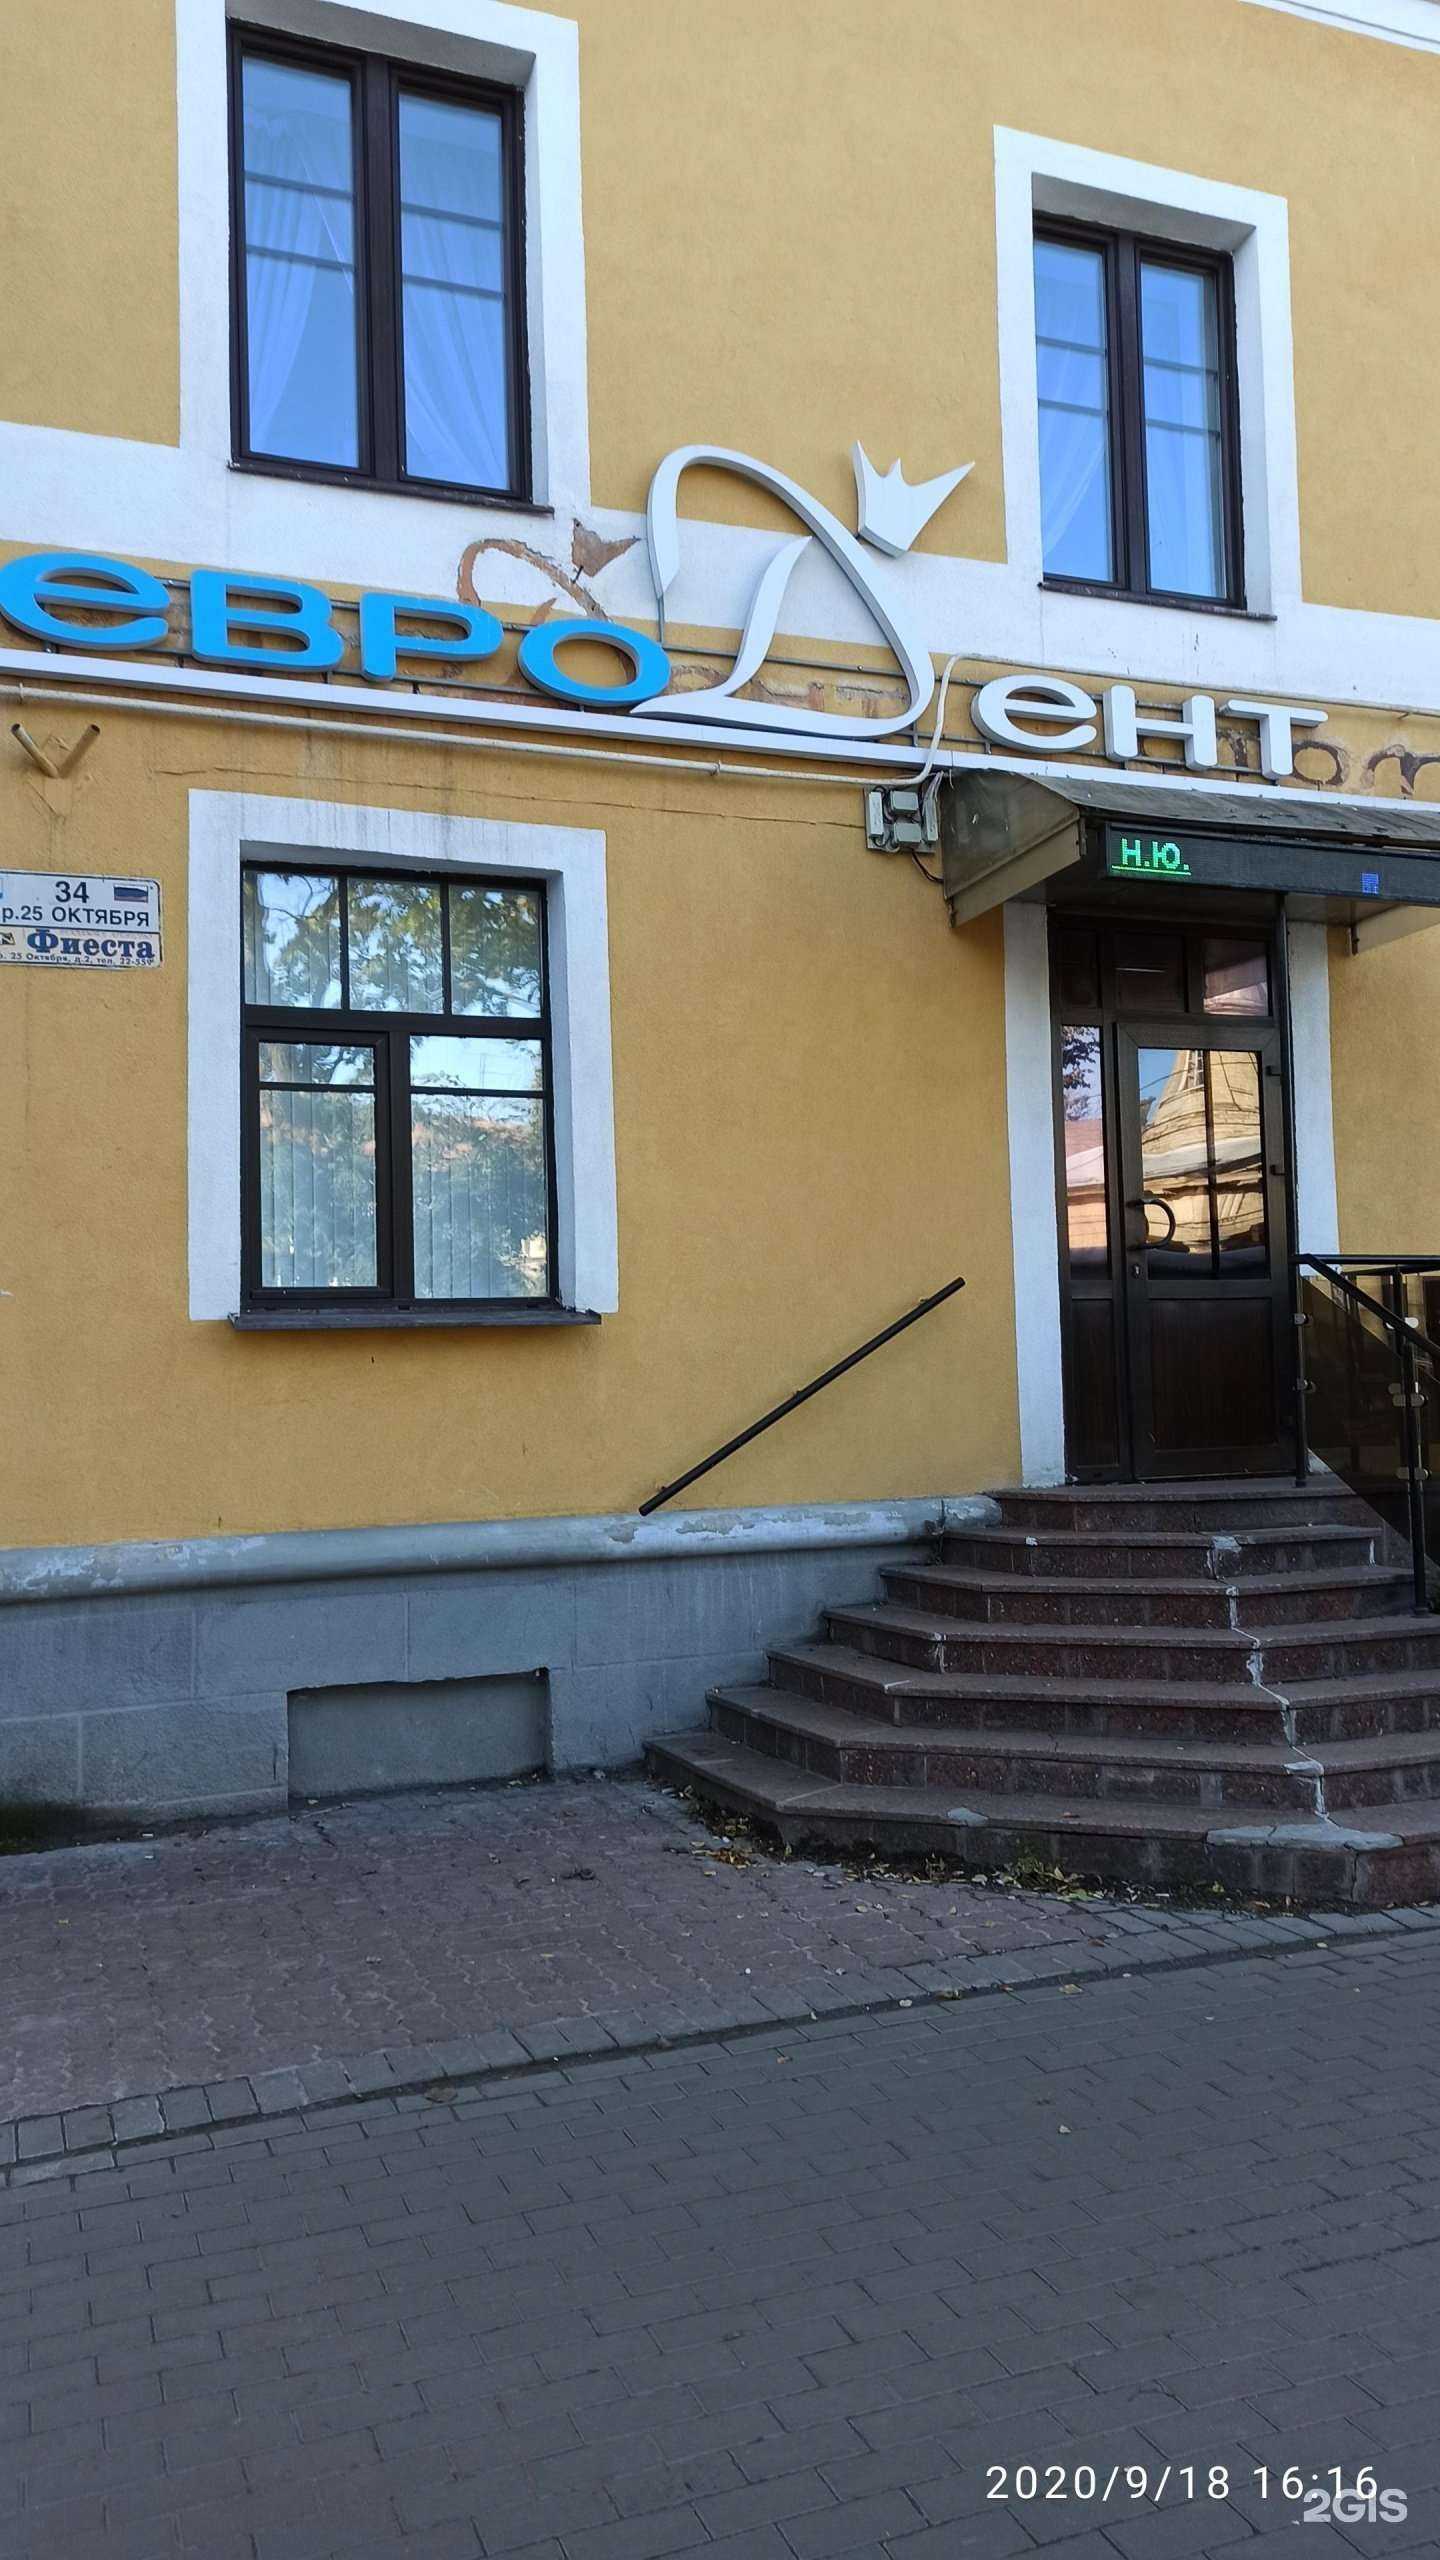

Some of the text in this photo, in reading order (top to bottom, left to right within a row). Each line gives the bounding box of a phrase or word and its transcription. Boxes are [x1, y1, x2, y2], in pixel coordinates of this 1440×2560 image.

[55, 881, 89, 904] 34
[52, 906, 149, 927] ОКТЯБРЯ
[27, 928, 155, 959] Фиеста
